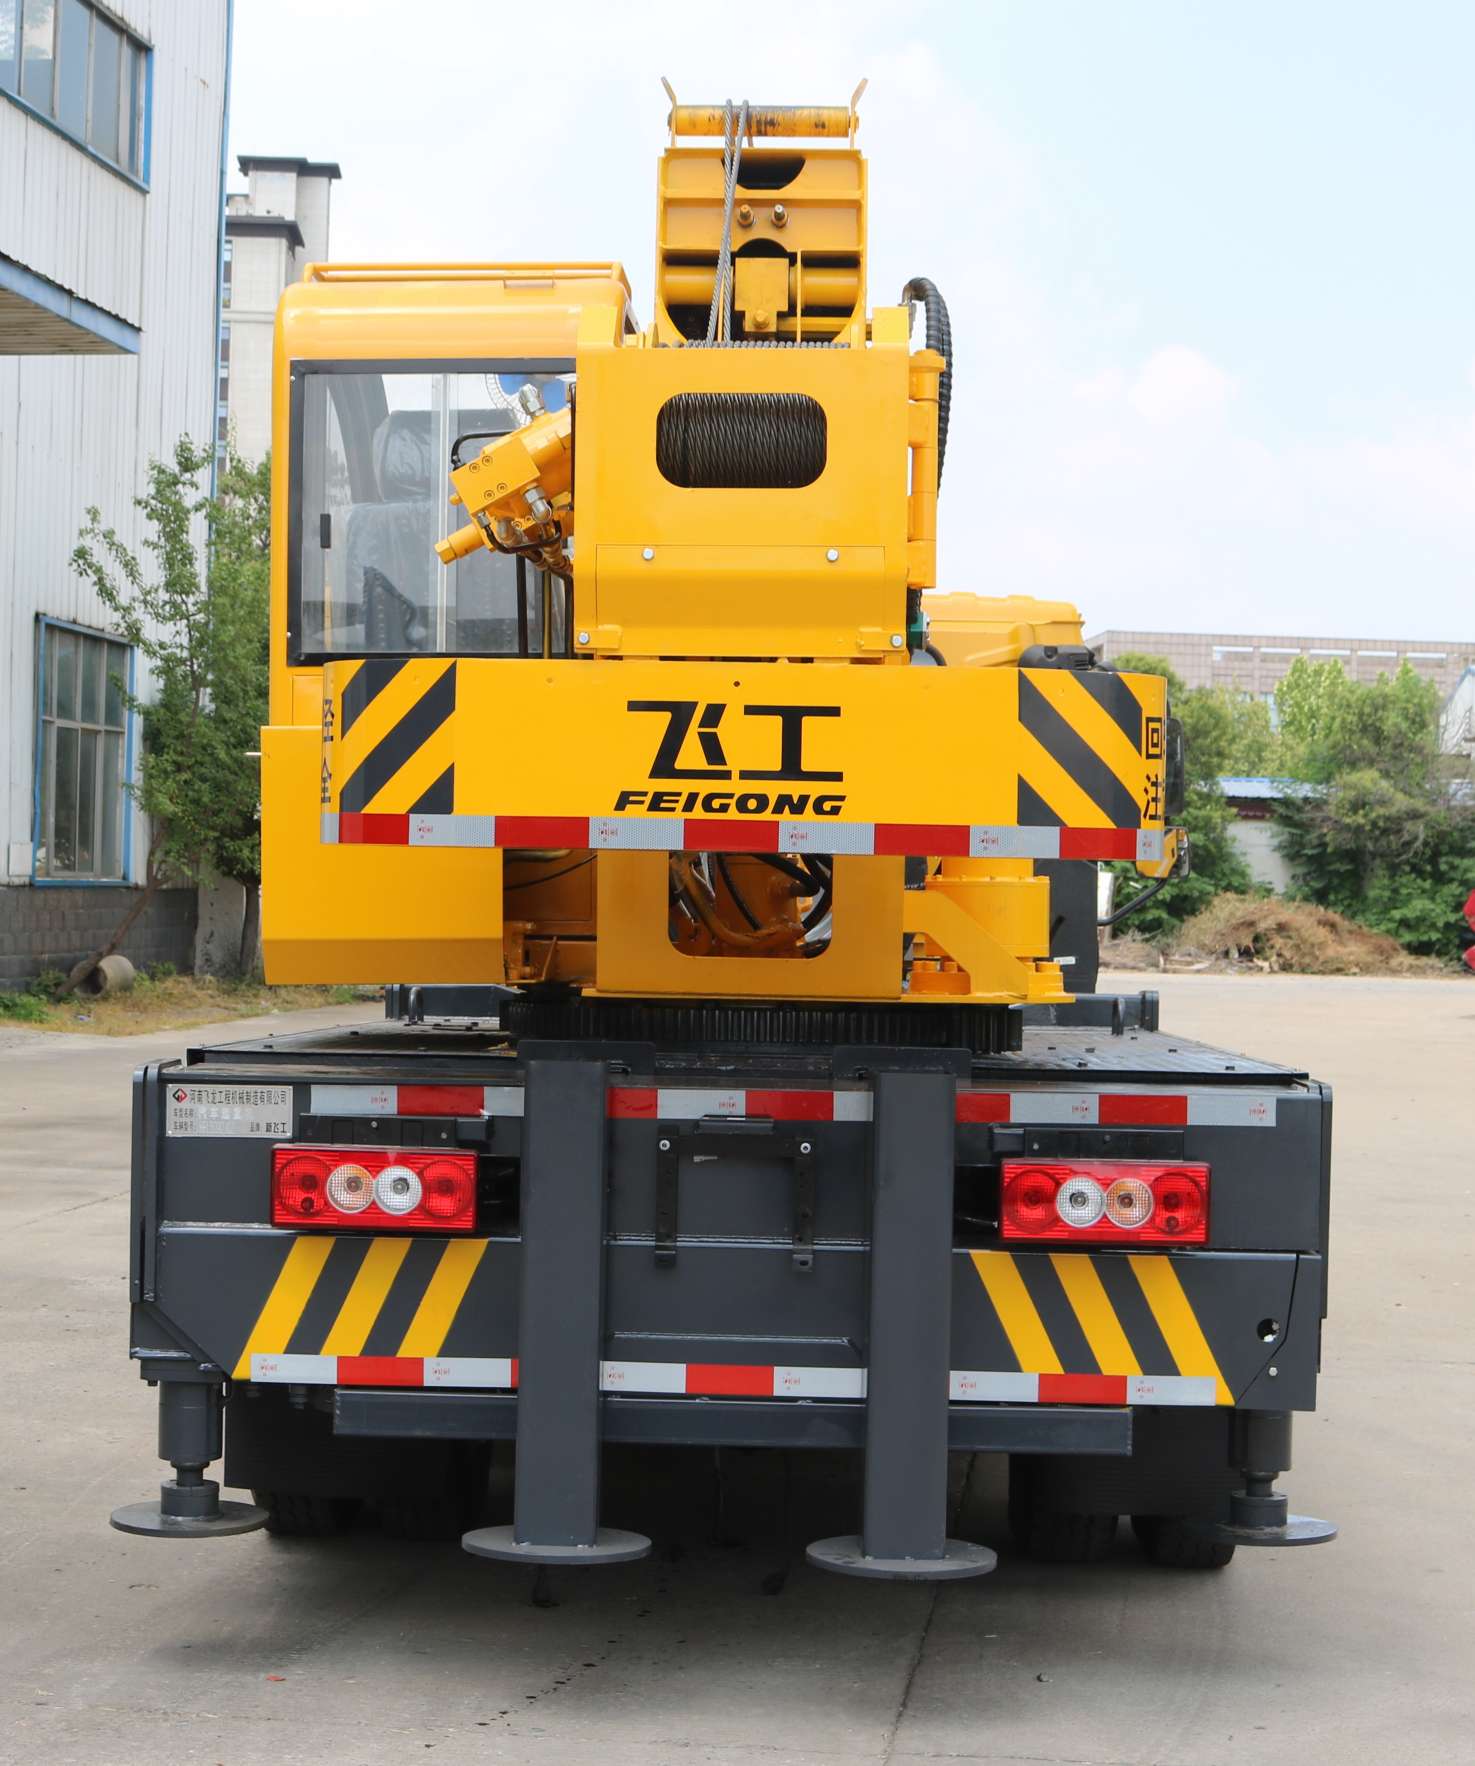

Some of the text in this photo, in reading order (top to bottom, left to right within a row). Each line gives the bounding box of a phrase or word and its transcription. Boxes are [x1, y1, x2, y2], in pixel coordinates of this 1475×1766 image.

[626, 700, 844, 782] 飞工
[1145, 716, 1163, 760] 回
[613, 790, 847, 816] FEIGONG
[1143, 773, 1163, 821] 注
